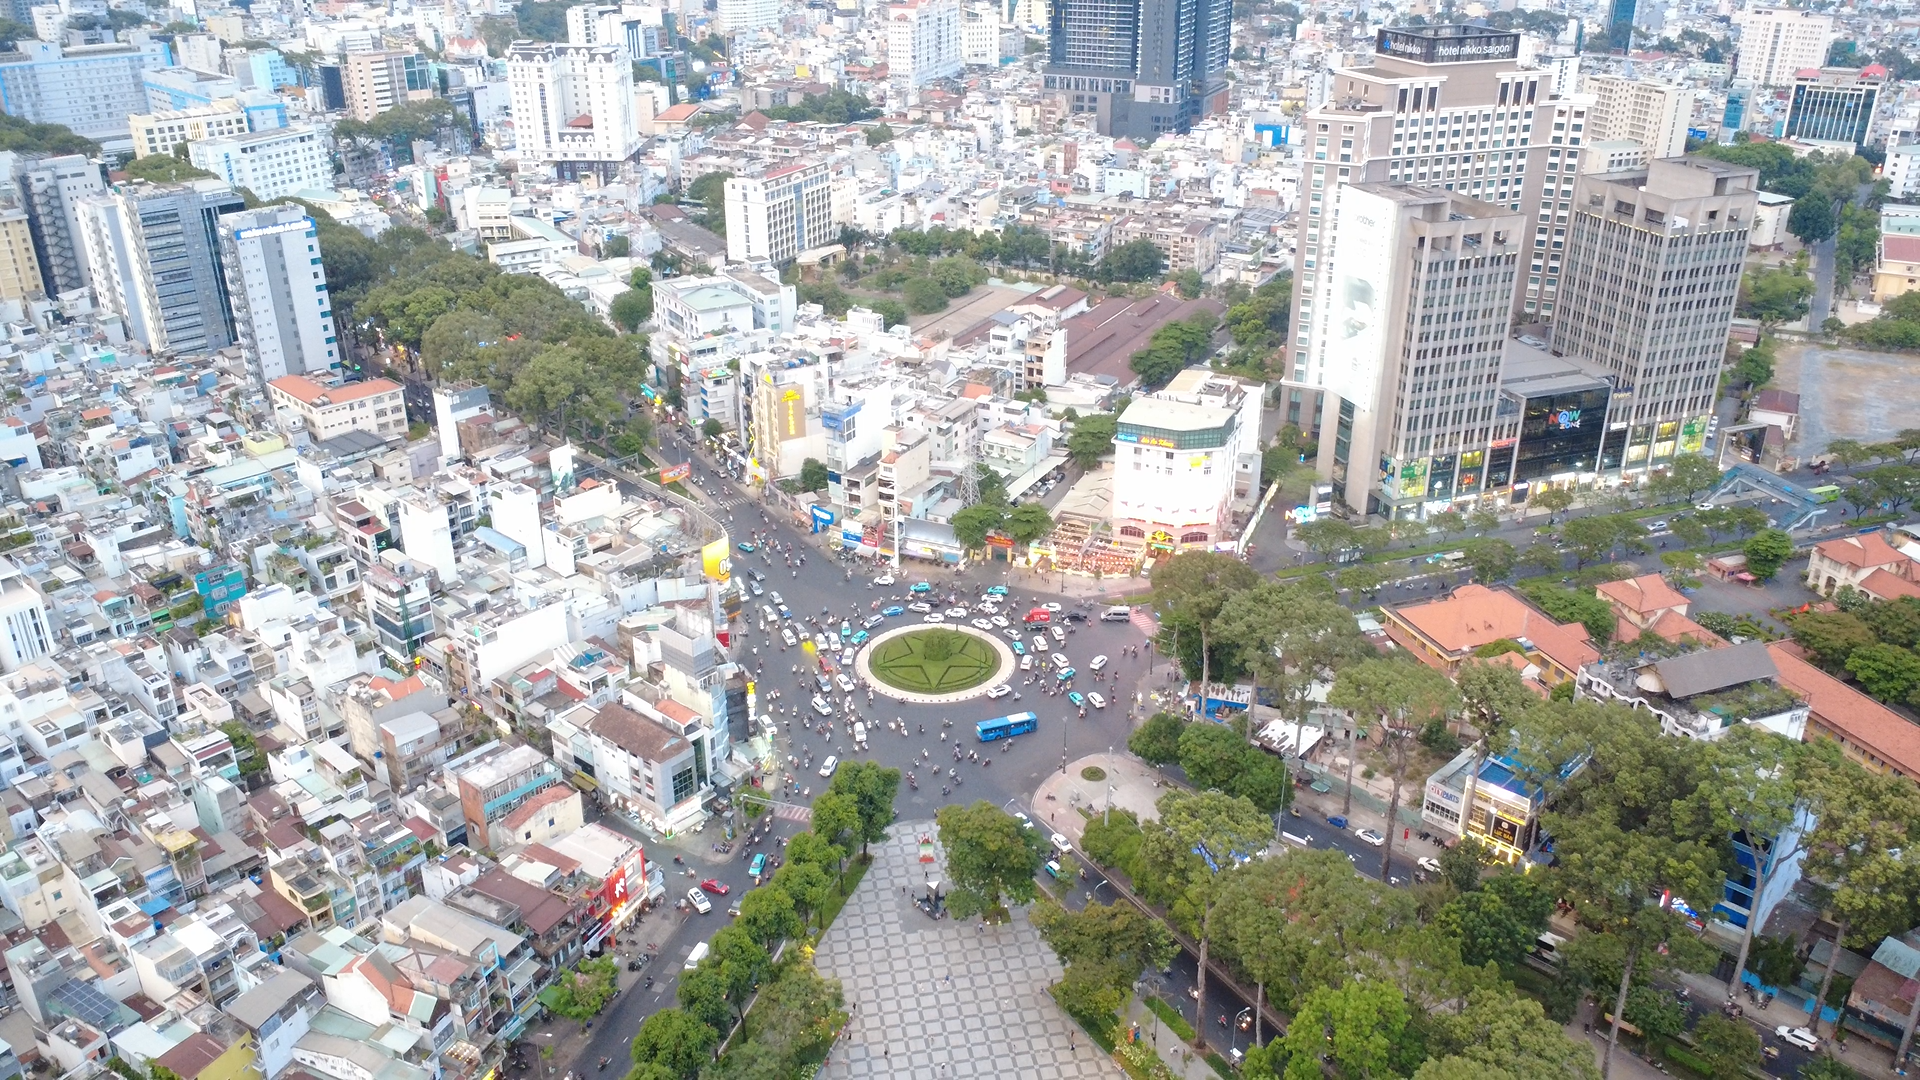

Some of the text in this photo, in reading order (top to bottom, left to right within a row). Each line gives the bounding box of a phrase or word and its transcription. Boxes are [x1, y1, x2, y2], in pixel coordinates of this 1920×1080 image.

[1390, 41, 1421, 55] hotel nikko
[1439, 44, 1510, 56] hotel nikko saigon
[1548, 409, 1581, 425] NOW
